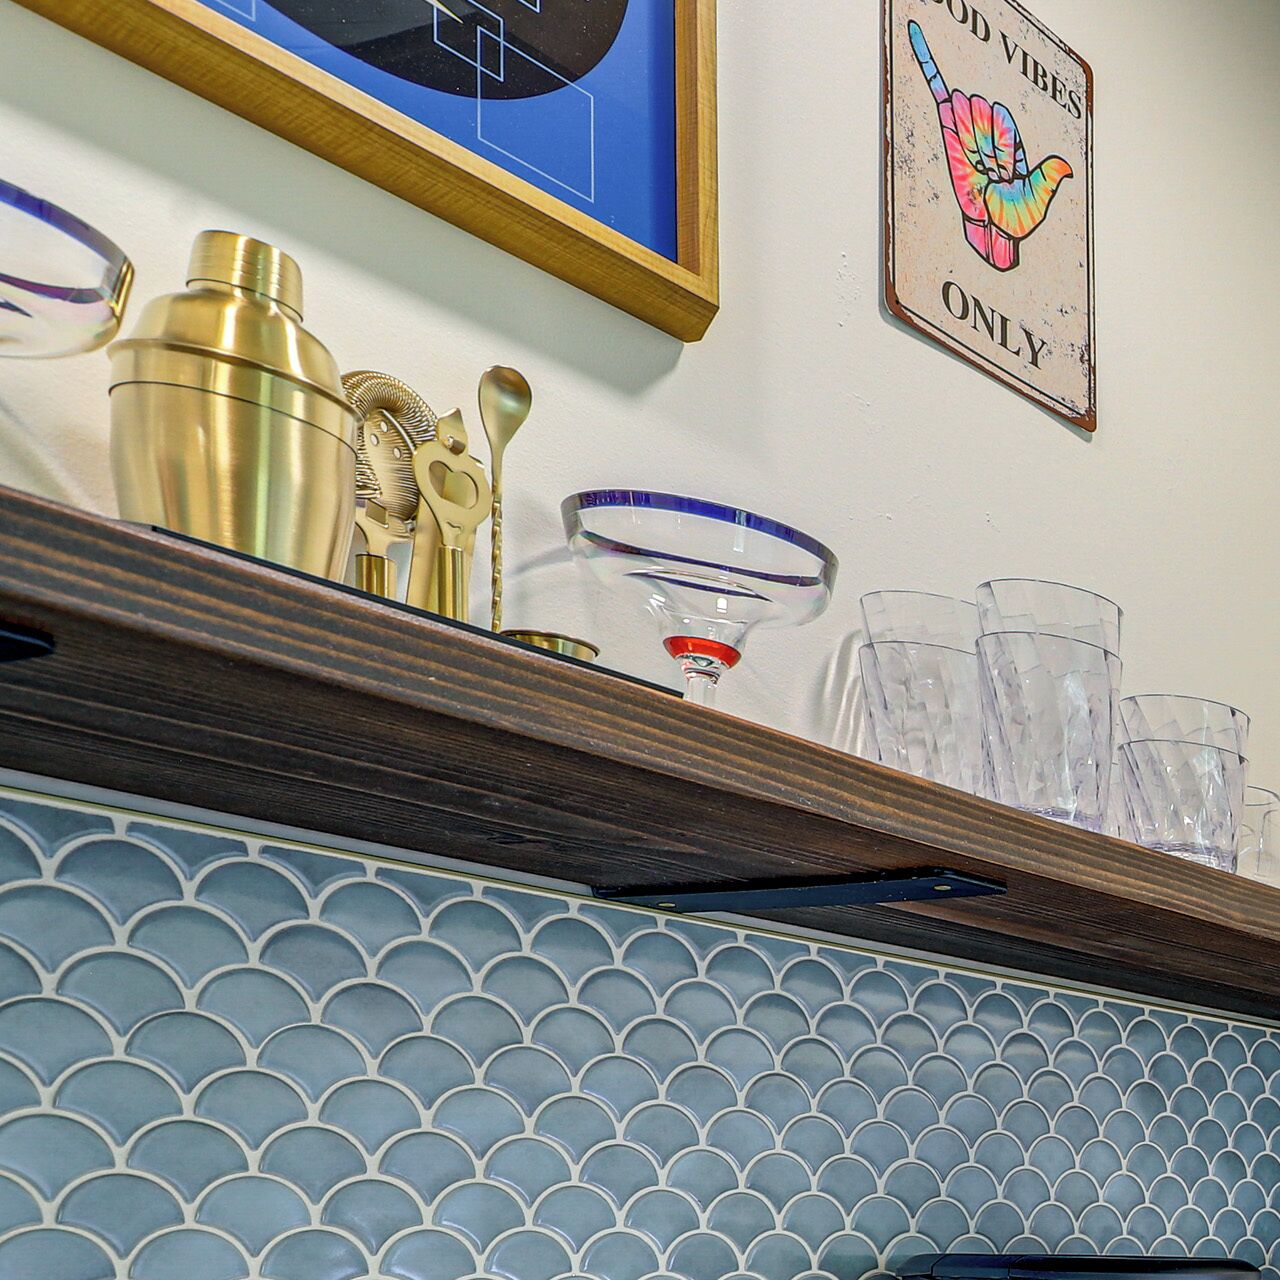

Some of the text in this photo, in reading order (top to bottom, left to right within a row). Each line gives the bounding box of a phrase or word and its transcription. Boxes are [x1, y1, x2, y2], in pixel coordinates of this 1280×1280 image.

[932, 0, 1082, 119] OD VIBES
[942, 280, 1048, 370] ONLY
